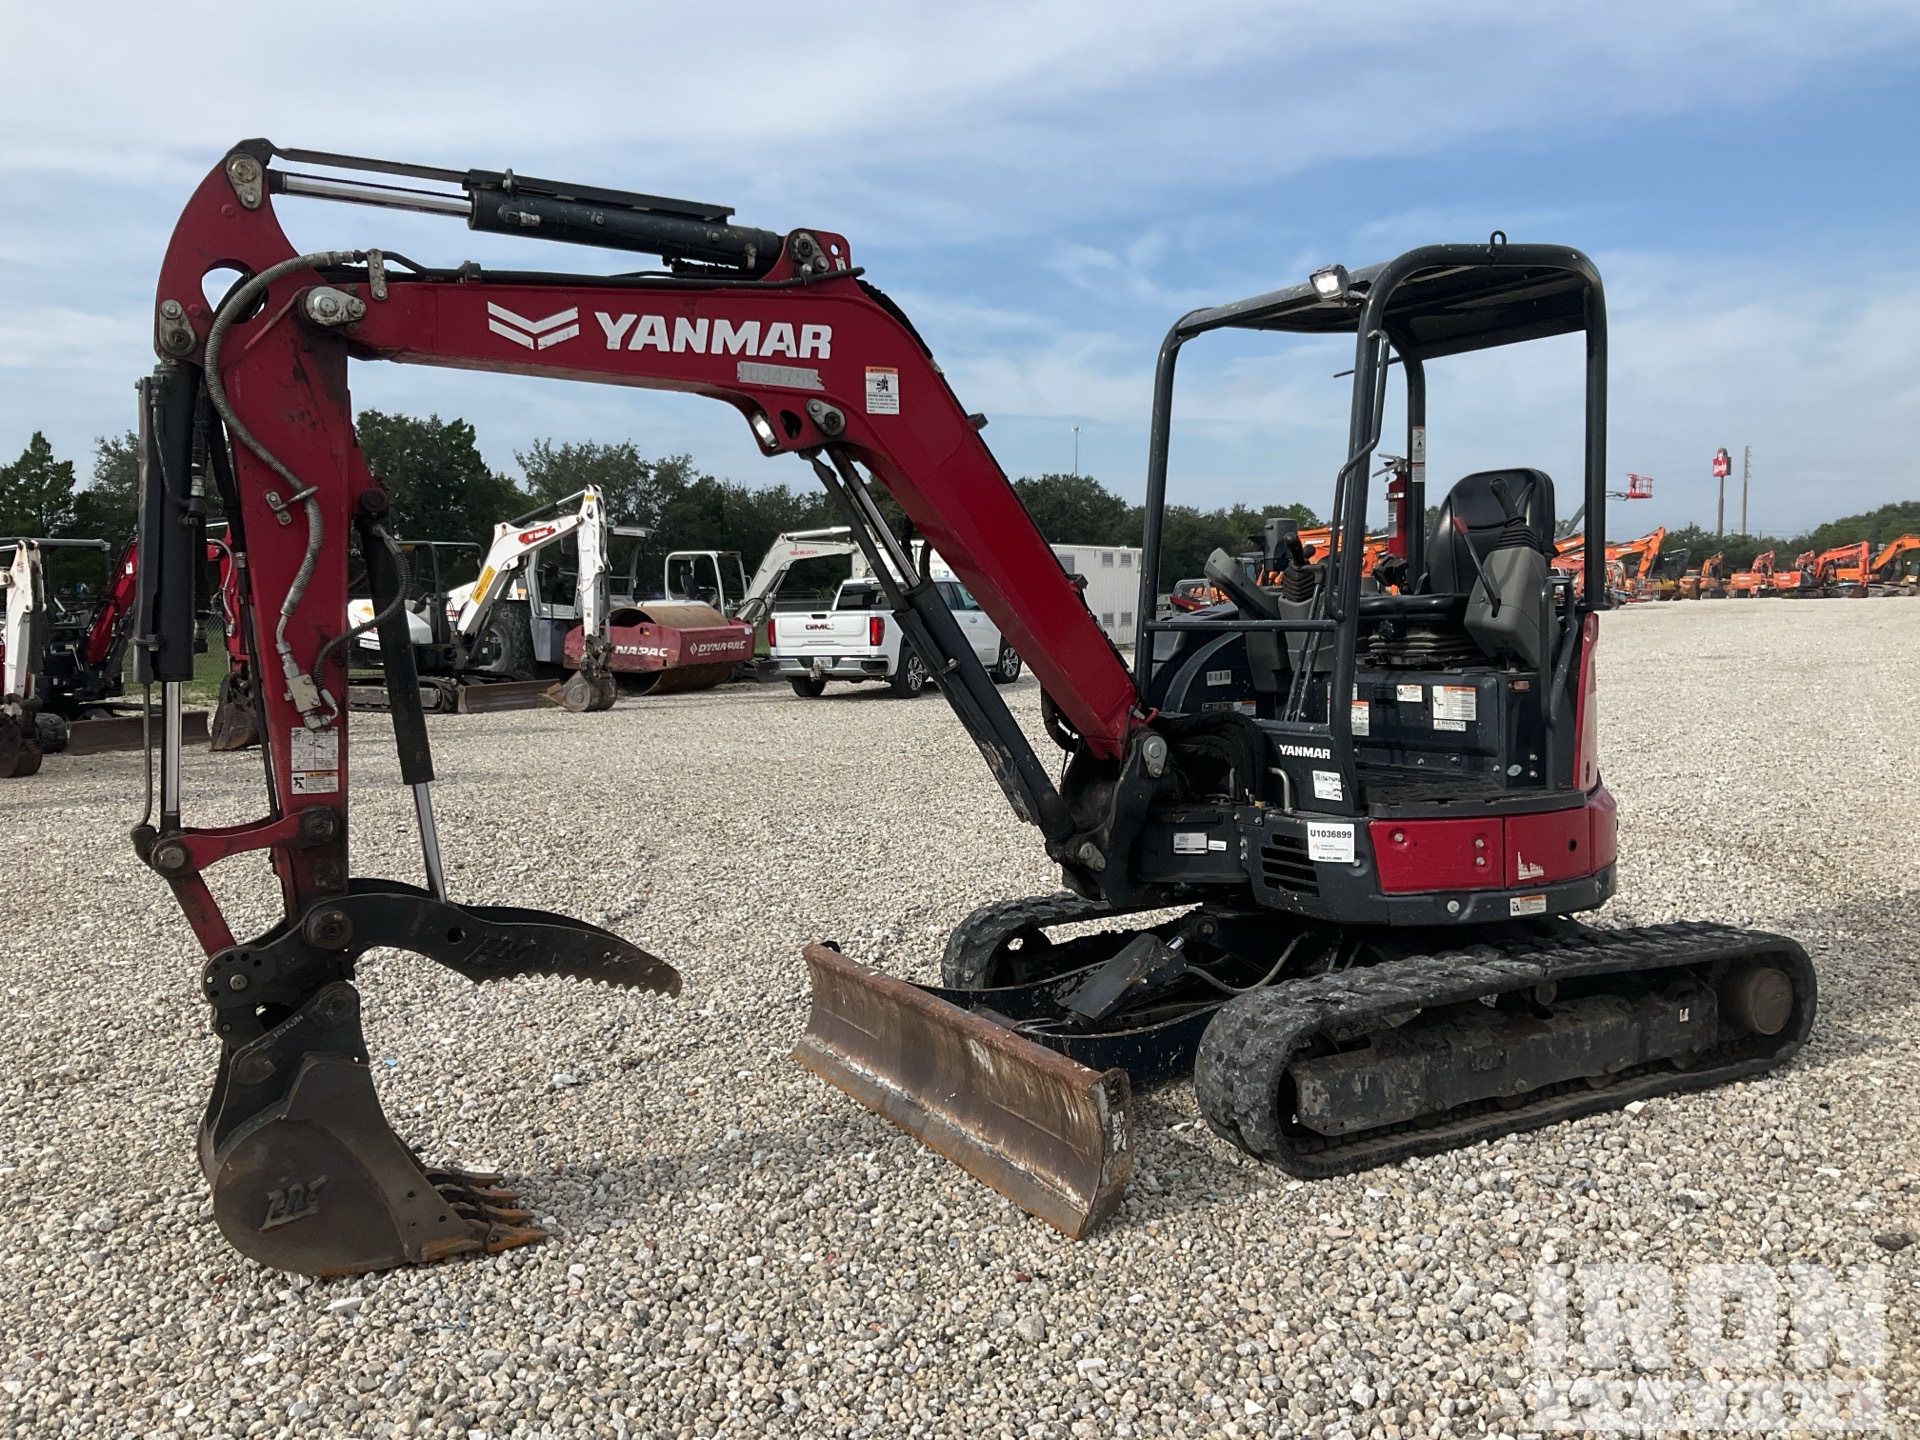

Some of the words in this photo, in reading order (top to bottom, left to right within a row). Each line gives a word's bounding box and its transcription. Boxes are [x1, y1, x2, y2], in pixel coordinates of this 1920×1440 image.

[594, 311, 832, 360] YANMAR
[805, 623, 832, 631] GMC
[614, 645, 669, 657] NAPAC
[698, 640, 747, 653] DYNAPAC
[1278, 744, 1331, 760] YANMAR
[1309, 829, 1353, 839] U1036899
